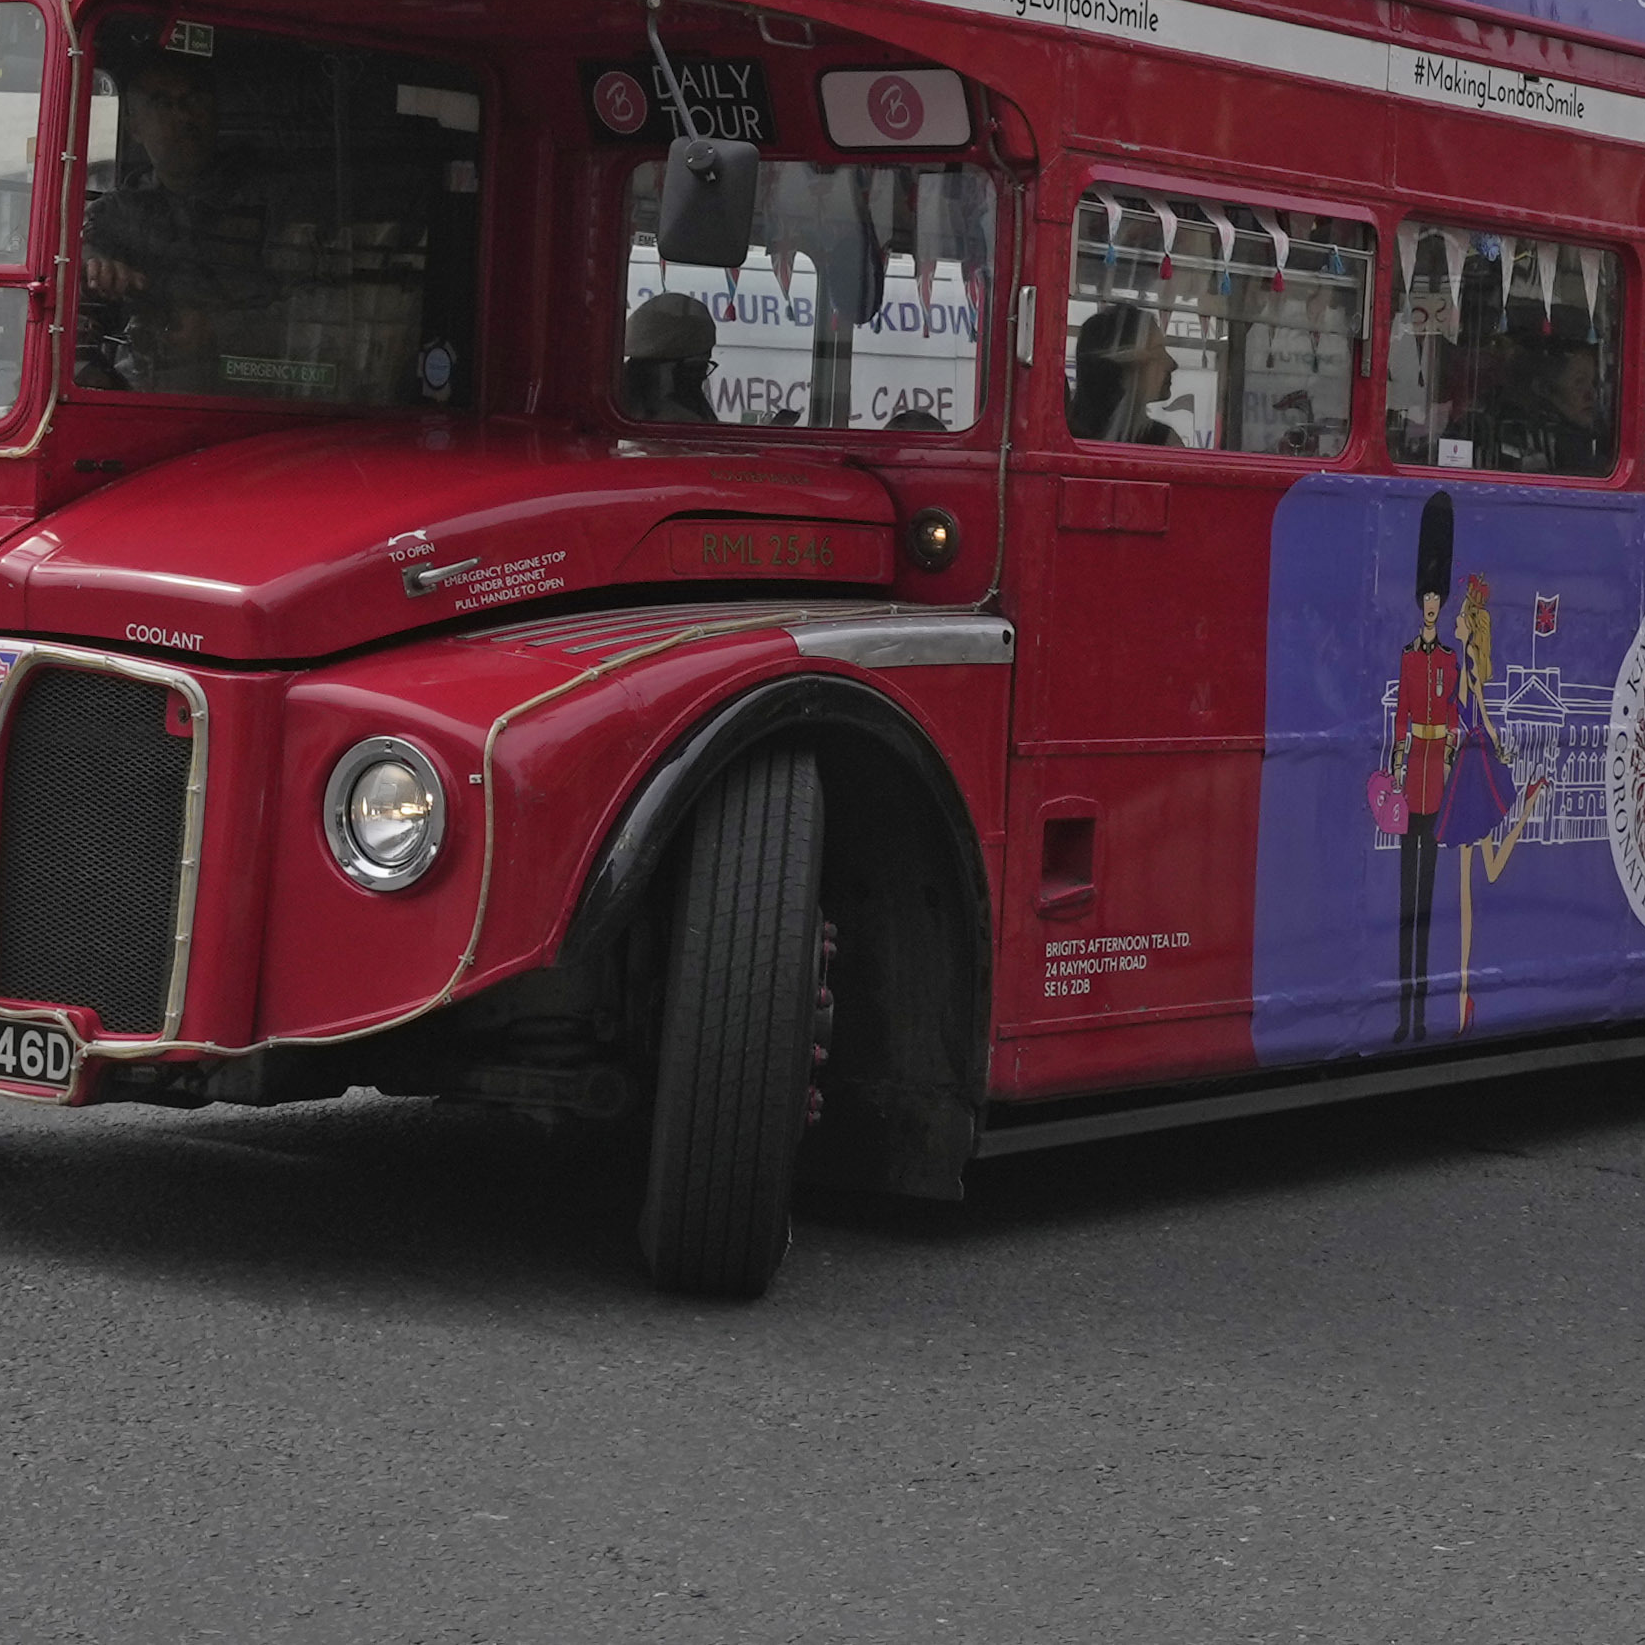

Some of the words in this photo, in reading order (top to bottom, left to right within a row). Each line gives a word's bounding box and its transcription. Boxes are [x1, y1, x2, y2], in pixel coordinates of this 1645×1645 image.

[652, 64, 751, 99] DAILY
[1414, 56, 1585, 119] #MakingLondonSmile
[661, 105, 763, 139] TOUR
[227, 360, 298, 379] EMERGENCY
[301, 366, 328, 382] EXIT
[388, 551, 406, 563] TO
[407, 542, 435, 559] OPEN
[703, 533, 763, 565] RML
[768, 535, 834, 566] 2546
[444, 565, 503, 588] EMERGENCY
[504, 557, 541, 573] ENGINE
[542, 550, 567, 565] STOP
[469, 577, 504, 595] UNDER
[506, 568, 546, 586] BONNET
[455, 597, 479, 611] PULL
[480, 586, 522, 605] HANDLE
[522, 584, 536, 596] TO
[537, 577, 565, 593] OPEN
[125, 622, 204, 652] COOLANT
[1046, 939, 1086, 958] BRIGIT'S
[1087, 934, 1150, 954] AFTERNOON
[1151, 933, 1170, 949] TEA
[1171, 932, 1192, 947] LTD.
[1045, 962, 1057, 978] 24
[1059, 957, 1117, 977] RAYMOUTH
[1118, 954, 1148, 971] ROAD
[1044, 980, 1068, 997] SE16
[1070, 978, 1091, 995] 2DB
